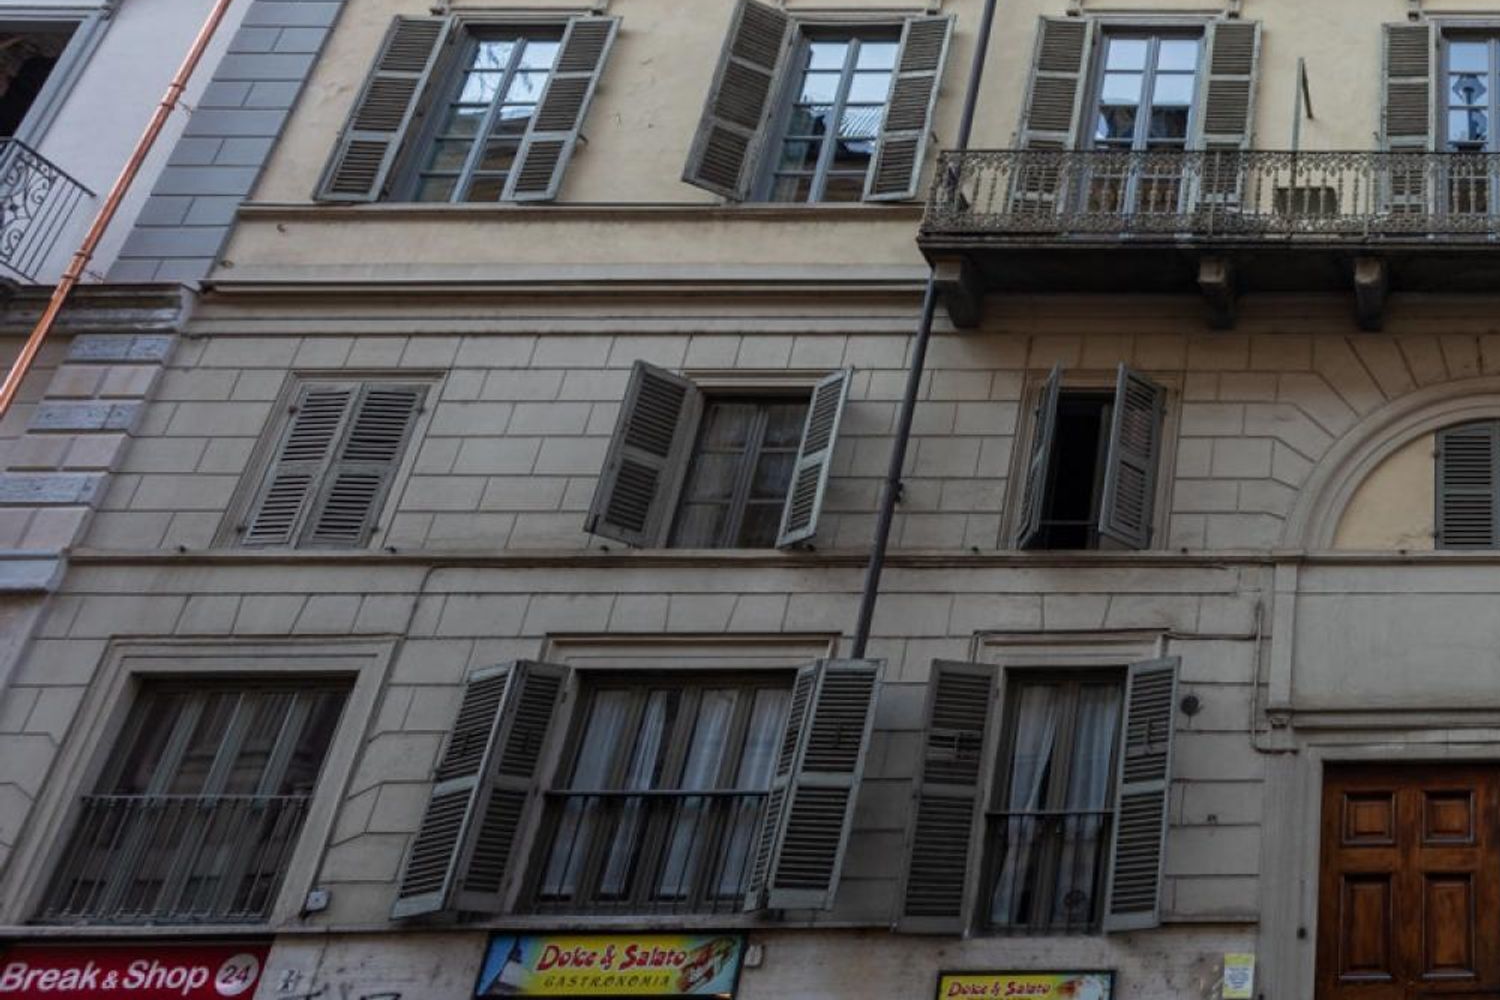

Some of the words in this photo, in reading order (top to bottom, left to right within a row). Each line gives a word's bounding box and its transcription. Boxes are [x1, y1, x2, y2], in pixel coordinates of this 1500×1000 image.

[536, 944, 597, 971] Dolce
[618, 943, 689, 970] Salato
[0, 961, 101, 992] Break
[101, 970, 120, 990] &
[122, 959, 210, 996] Shop
[220, 965, 250, 985] 24
[542, 974, 671, 989] GASTRONOMIA
